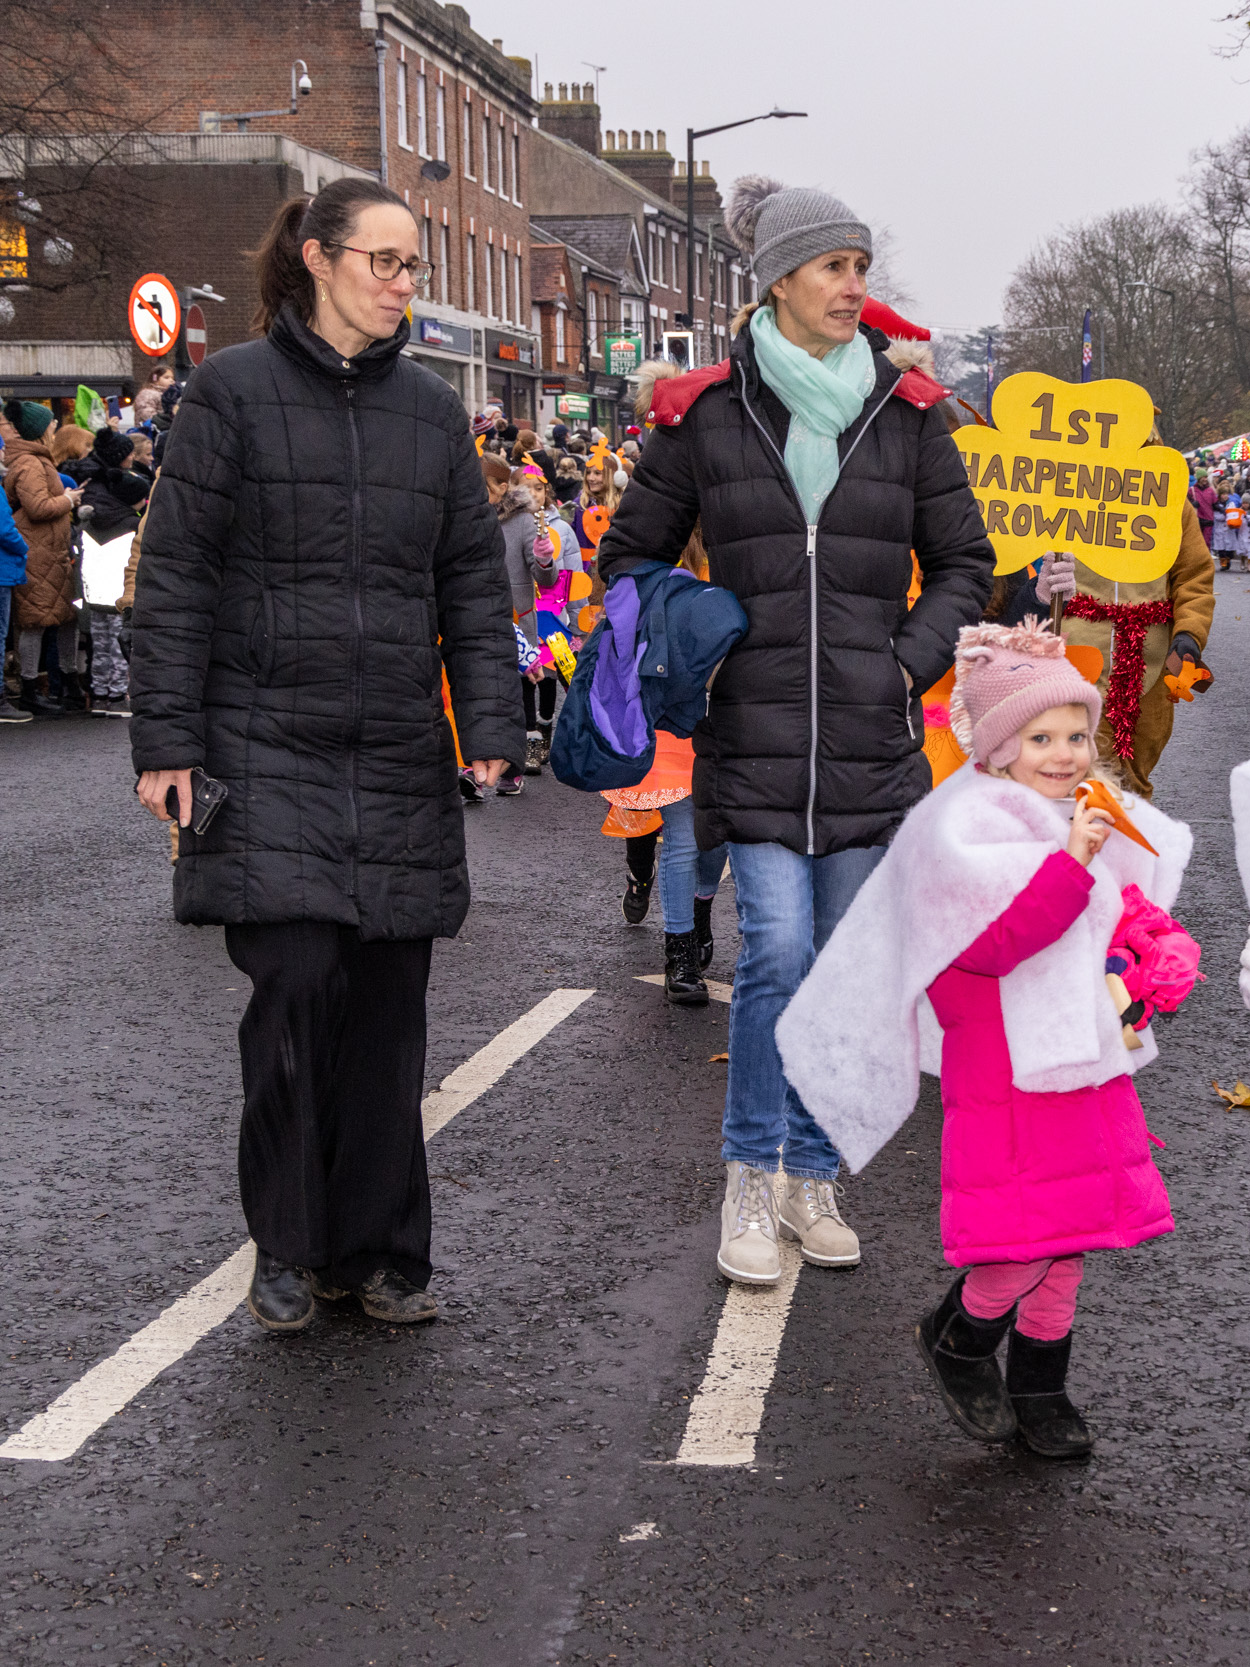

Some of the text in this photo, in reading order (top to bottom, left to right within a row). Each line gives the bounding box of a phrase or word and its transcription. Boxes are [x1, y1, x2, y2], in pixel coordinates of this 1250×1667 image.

[1029, 392, 1118, 448] 1ST
[958, 451, 1169, 507] HARPENDEN
[975, 499, 1157, 551] ROWNIES
